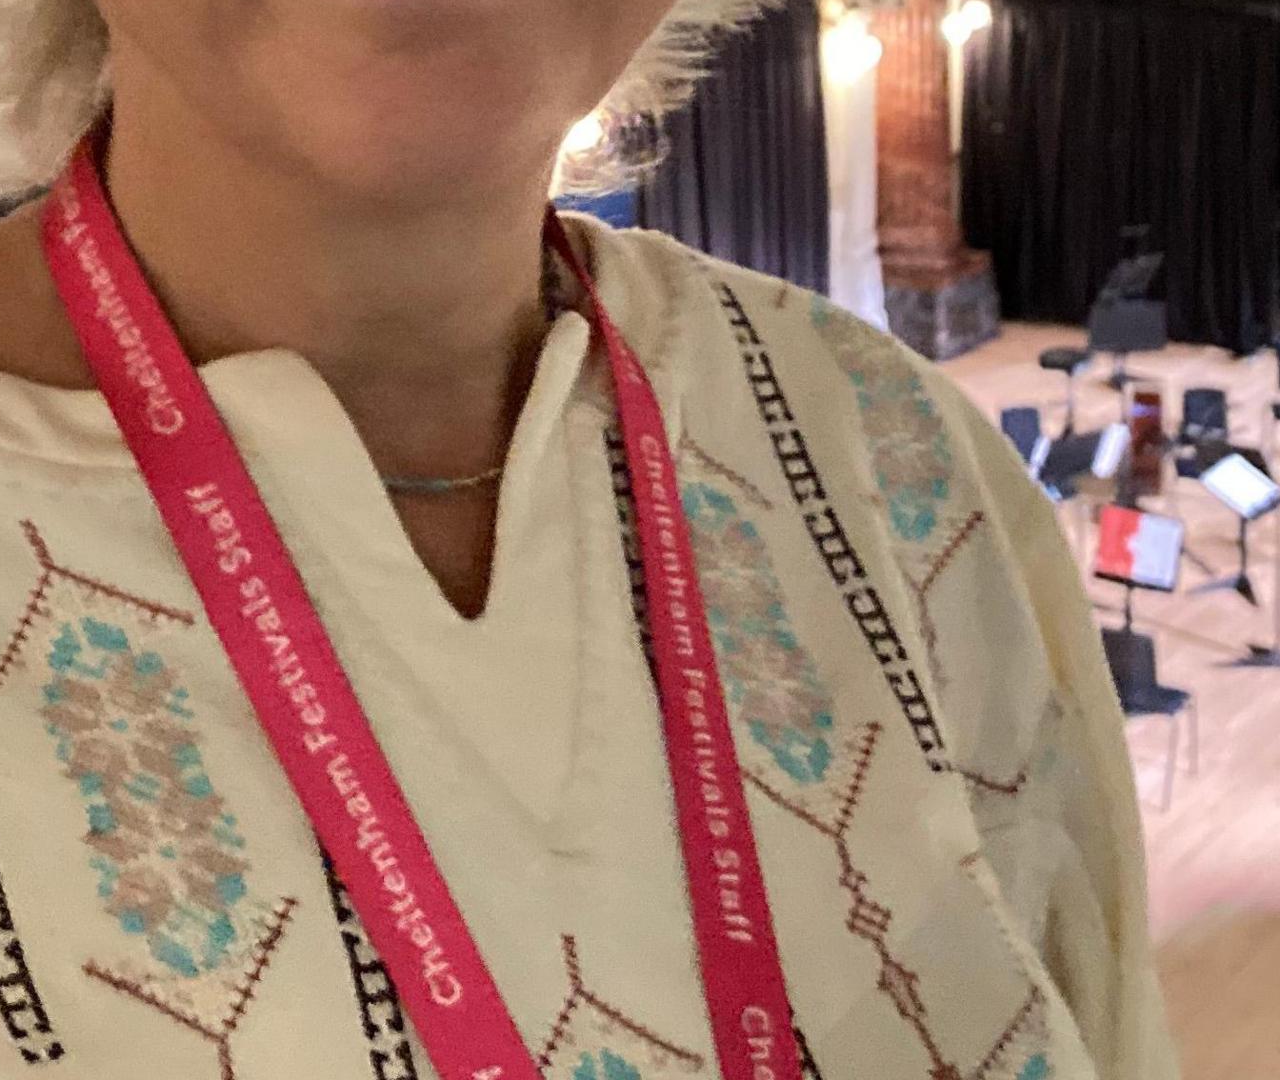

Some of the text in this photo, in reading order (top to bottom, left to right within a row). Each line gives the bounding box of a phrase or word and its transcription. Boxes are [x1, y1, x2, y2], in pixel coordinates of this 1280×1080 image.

[78, 237, 184, 435] Cheltenham
[184, 482, 462, 1006] Cheltenham Festivals Staff
[640, 435, 754, 943] Cheltenham Festivals Staff
